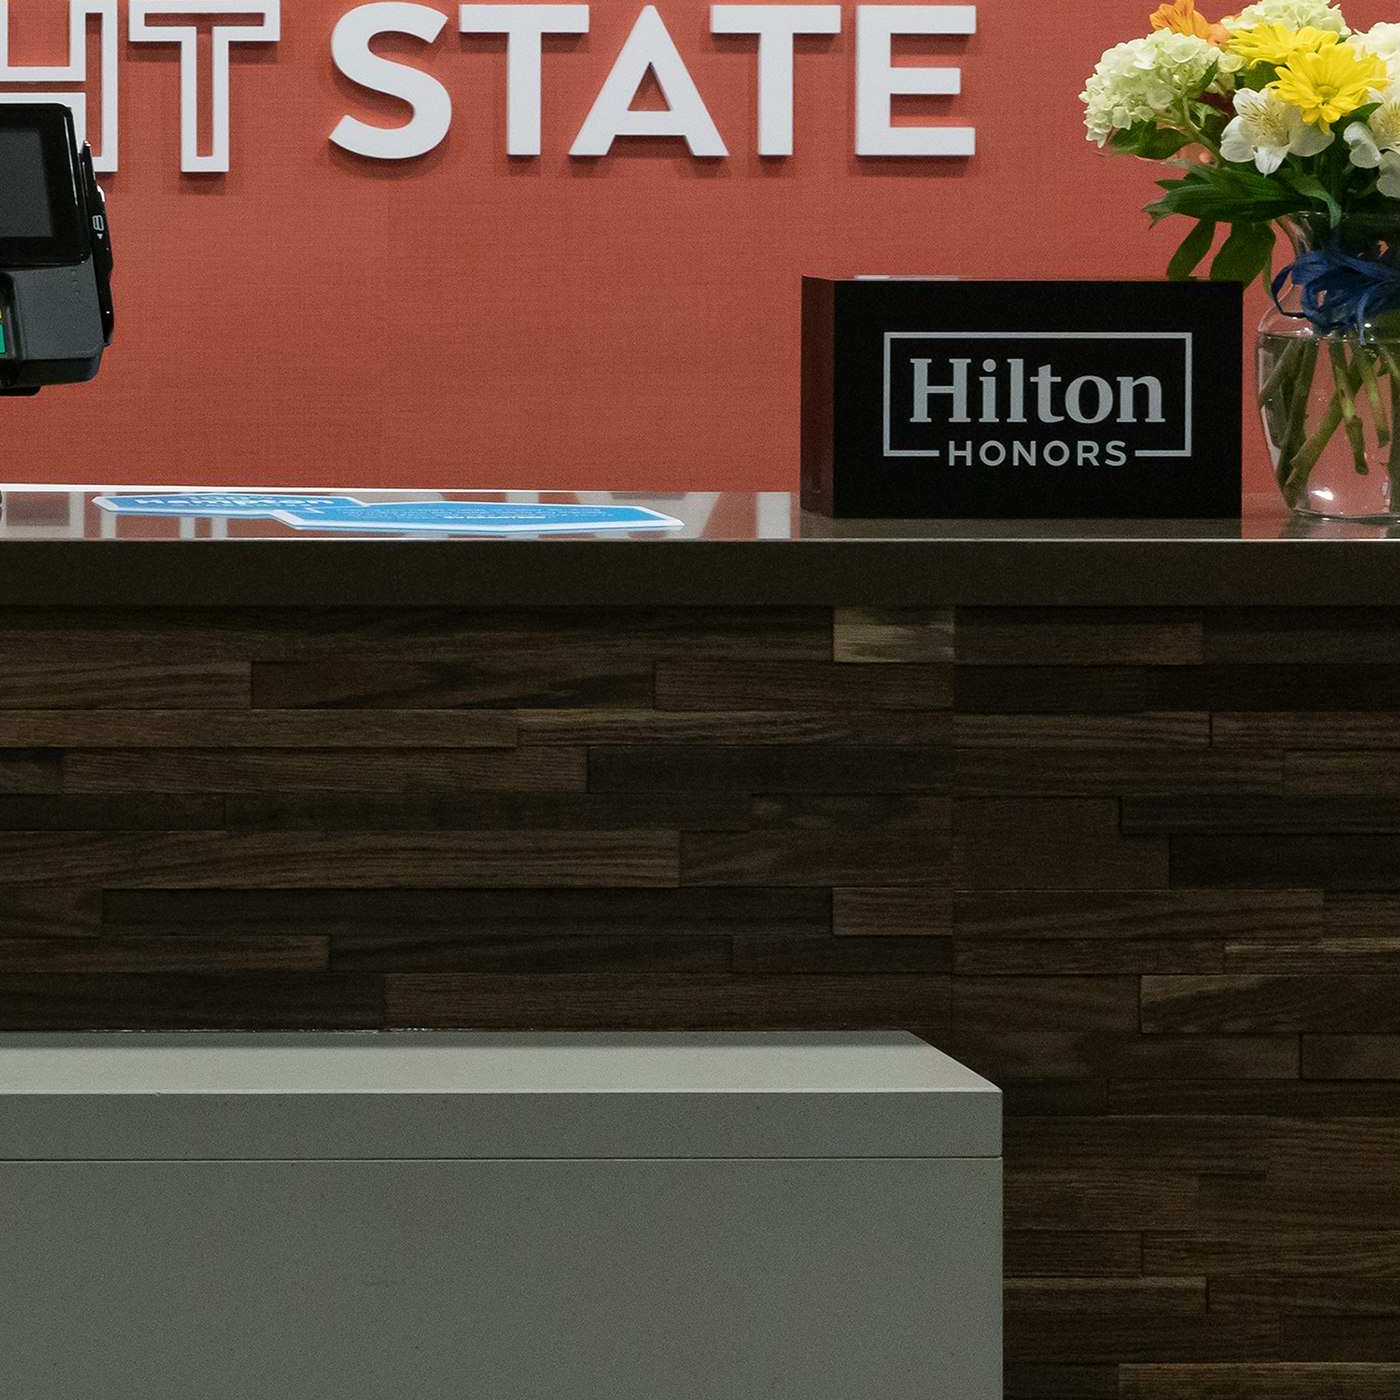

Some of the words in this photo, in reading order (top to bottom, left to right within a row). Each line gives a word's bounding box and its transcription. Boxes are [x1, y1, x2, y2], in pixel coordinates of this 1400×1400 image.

[328, 1, 977, 159] STATE
[909, 357, 1166, 425] Hilton
[947, 439, 1128, 468] HONORS
